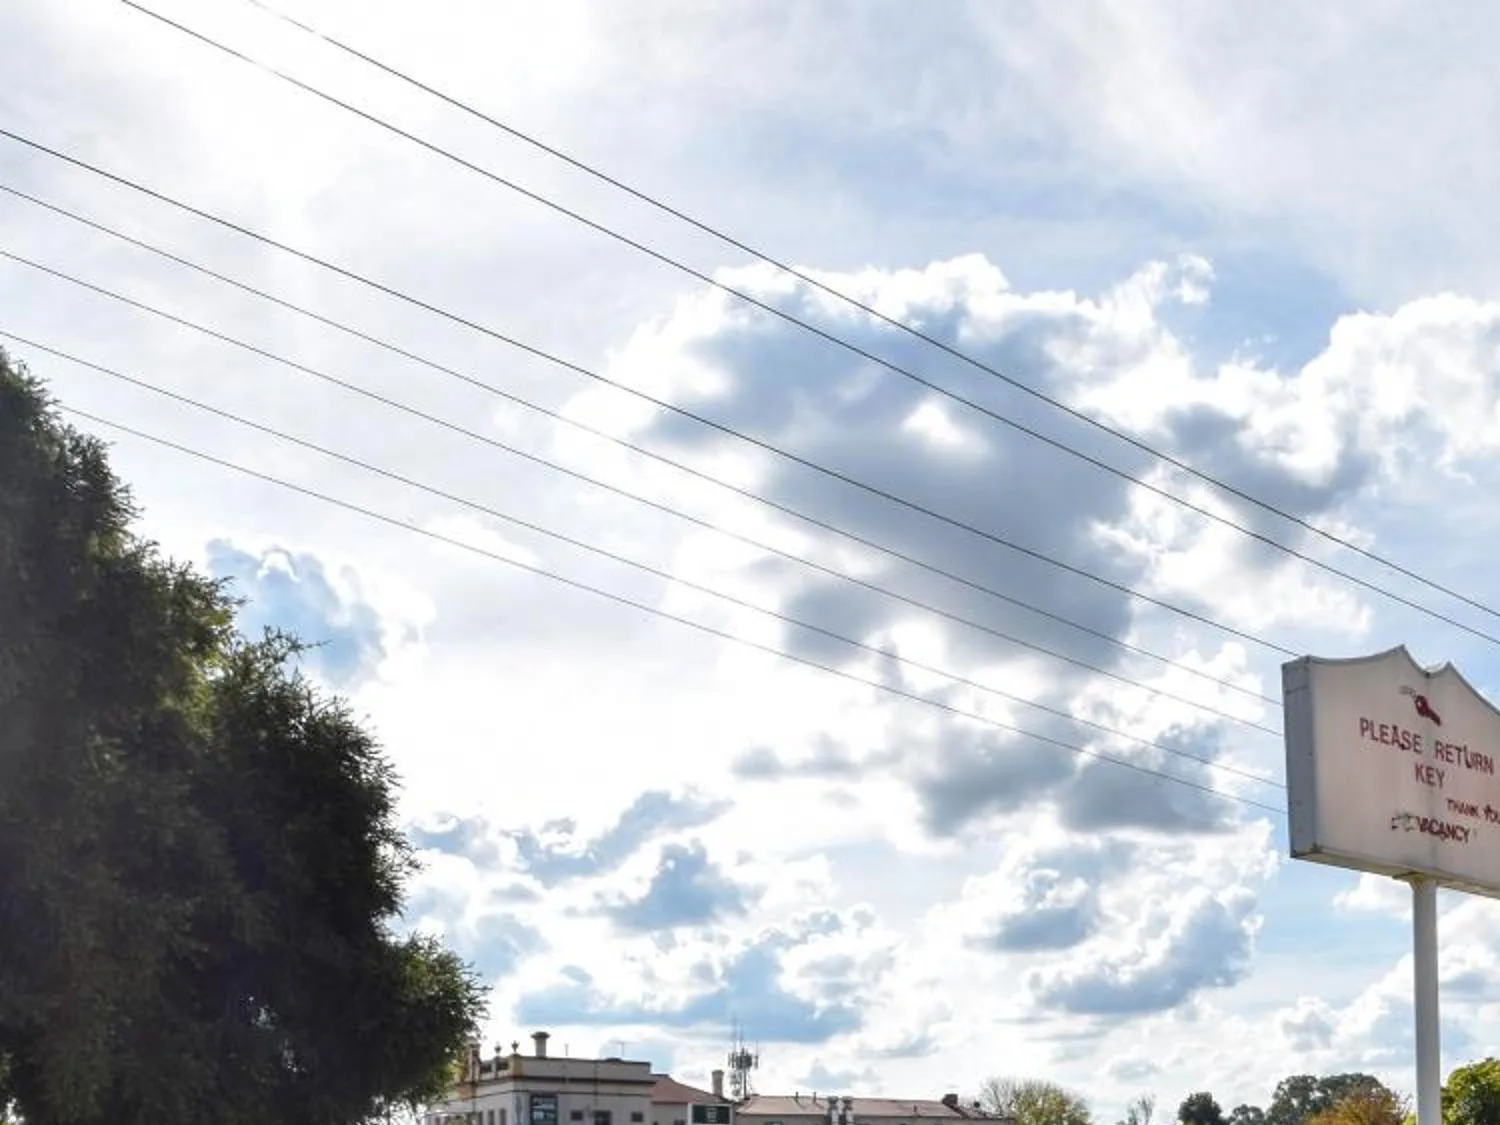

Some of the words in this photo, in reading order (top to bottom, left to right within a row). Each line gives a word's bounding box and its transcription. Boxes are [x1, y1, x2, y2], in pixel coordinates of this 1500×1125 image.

[1359, 717, 1422, 754] PLEASE
[1434, 740, 1495, 776] RETURN
[1414, 762, 1445, 789] KEY
[1446, 797, 1479, 817] THANK
[1418, 816, 1470, 843] VACANCY
